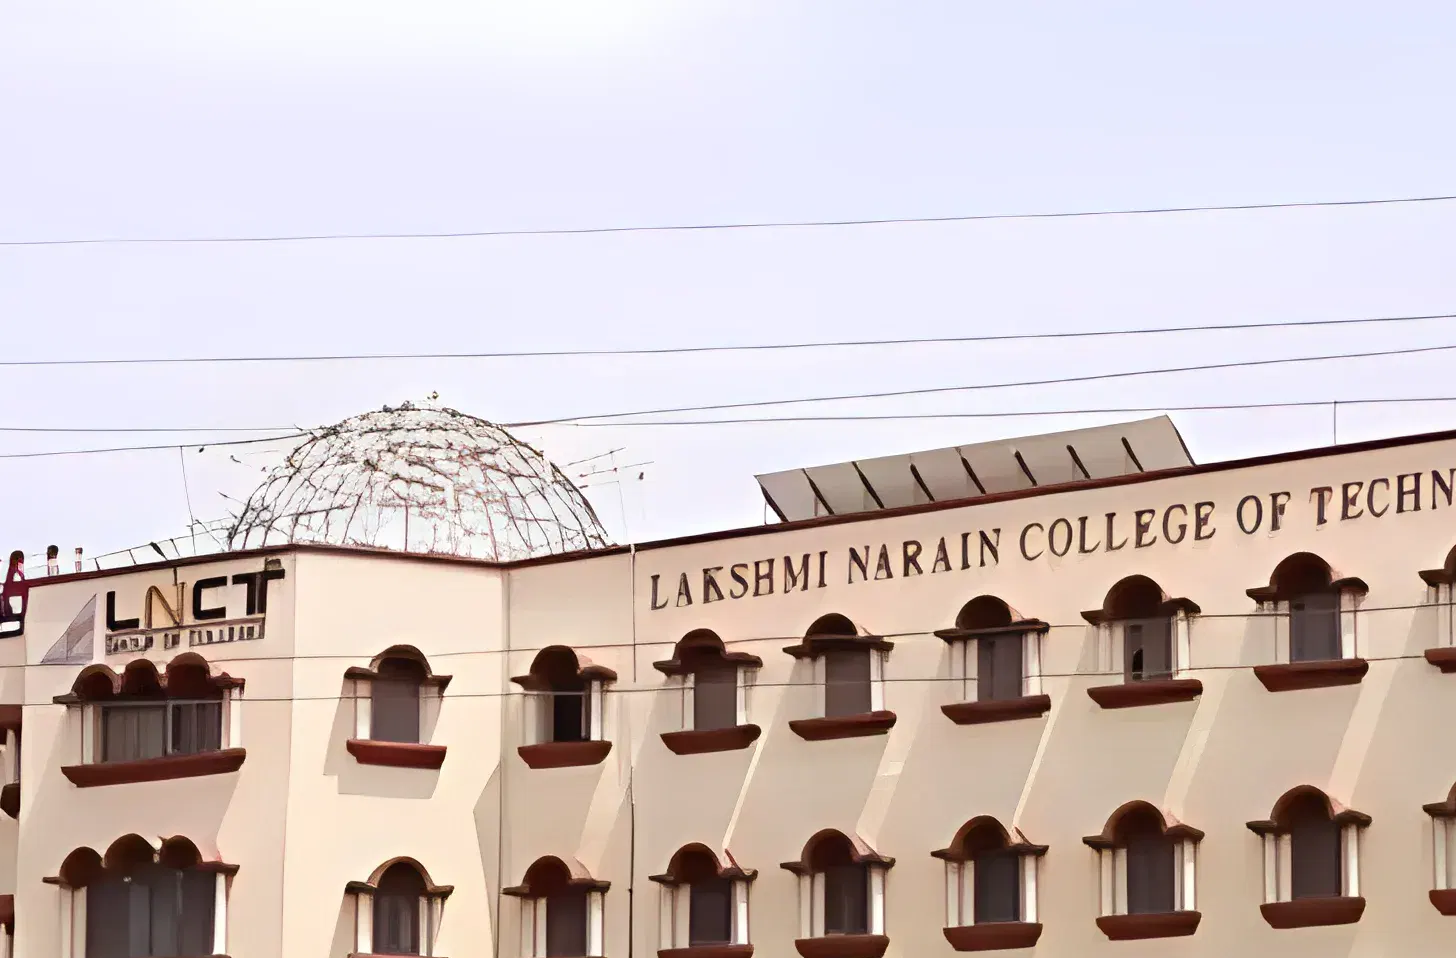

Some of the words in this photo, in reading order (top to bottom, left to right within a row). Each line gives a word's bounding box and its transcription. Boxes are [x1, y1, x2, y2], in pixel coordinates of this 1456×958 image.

[650, 550, 827, 610] LAKSHMI
[848, 528, 1001, 584] NARAIN
[1019, 501, 1216, 561] COLLEGE
[1236, 491, 1290, 534] OF
[106, 569, 285, 631] LNCT
